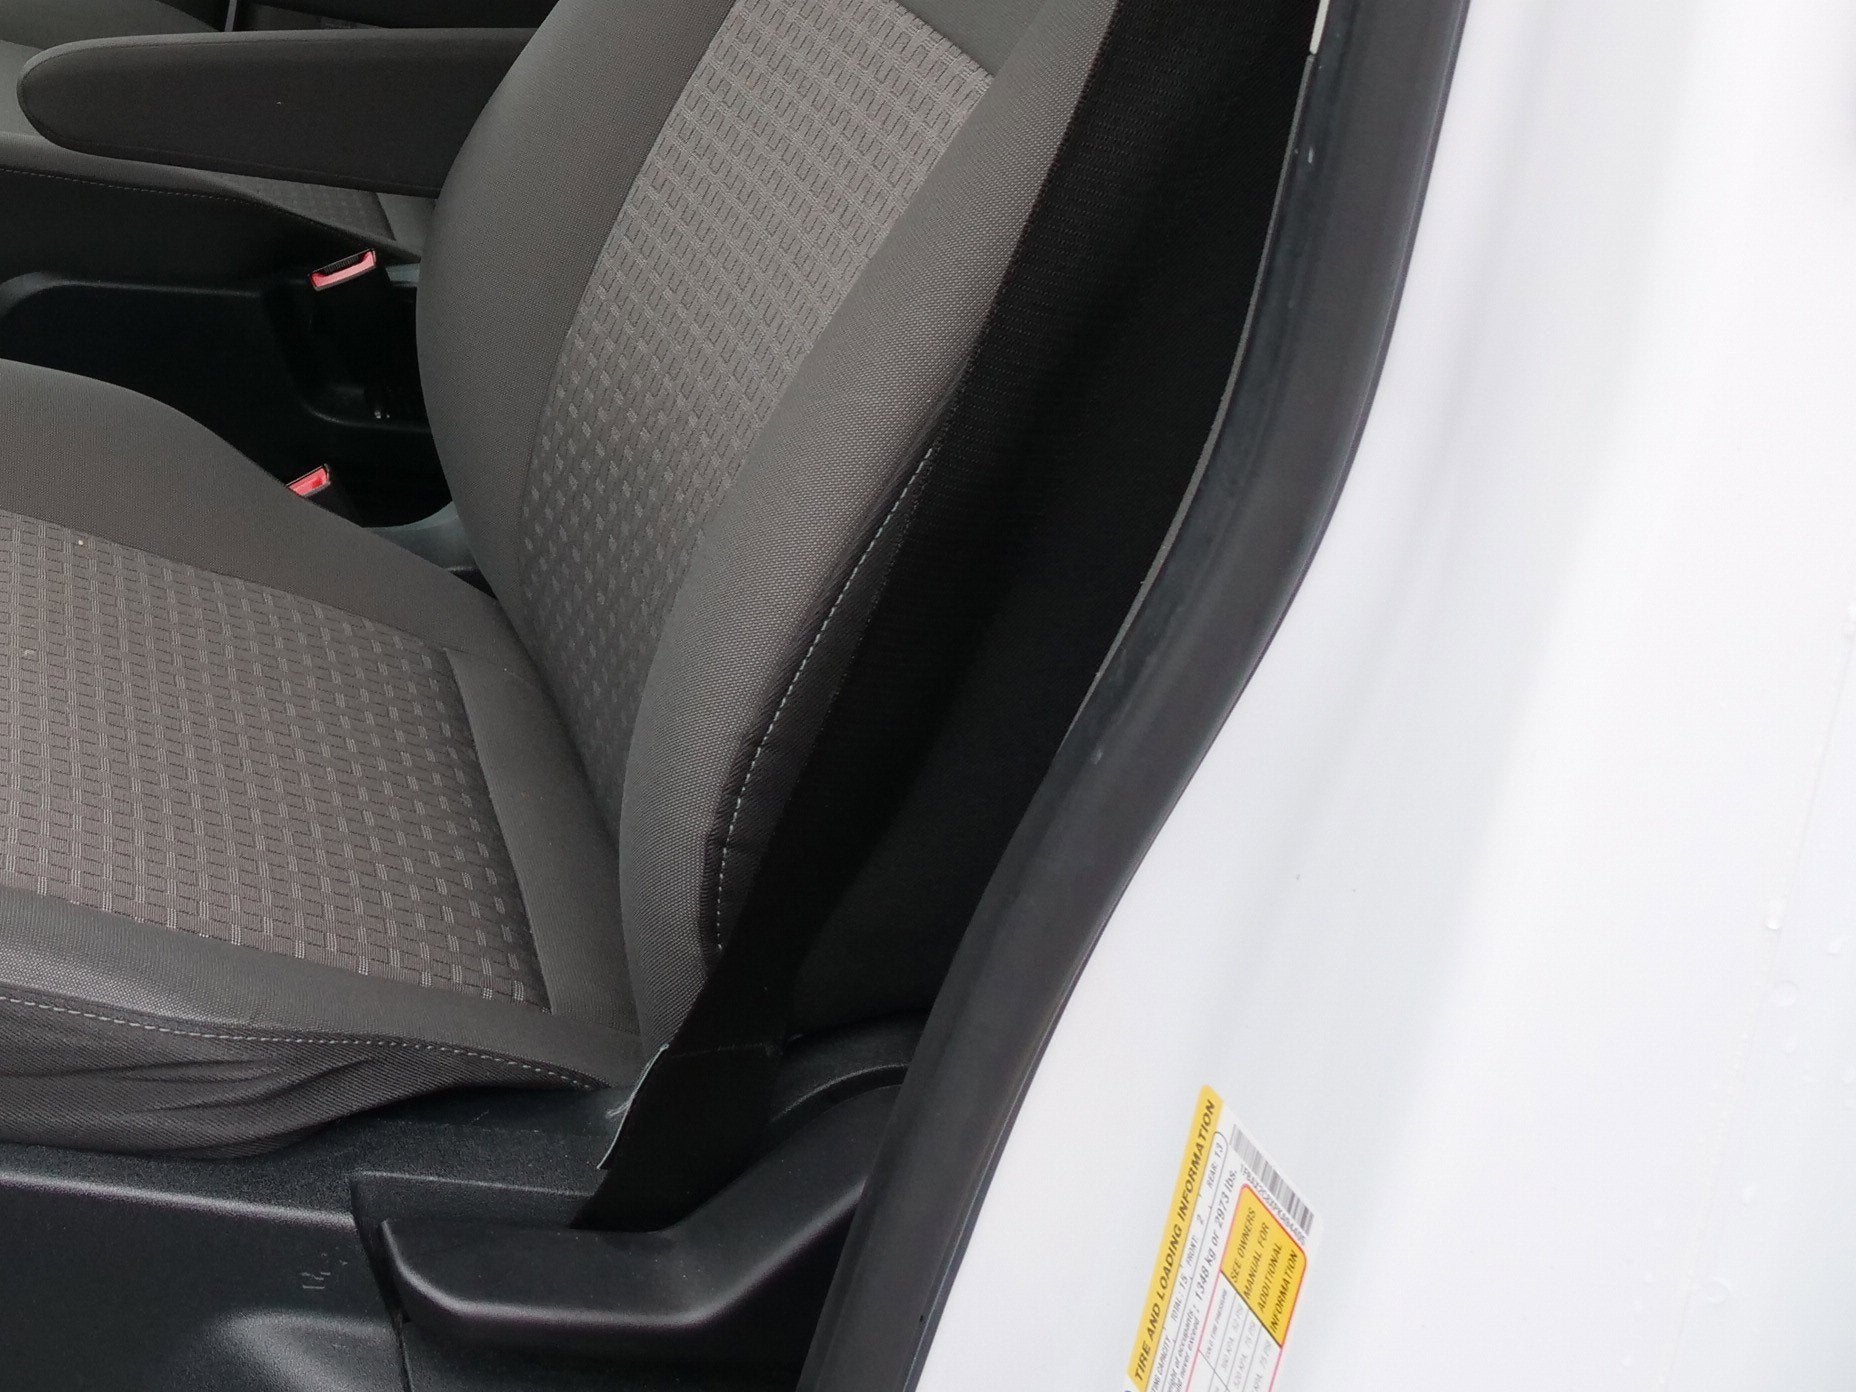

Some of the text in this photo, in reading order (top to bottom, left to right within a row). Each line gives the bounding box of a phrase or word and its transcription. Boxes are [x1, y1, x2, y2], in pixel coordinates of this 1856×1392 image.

[1214, 1142, 1223, 1158] 13
[1135, 1100, 1214, 1380] TIRE AND LOADING INFORMATION
[1195, 1265, 1209, 1300] 1348
[1204, 1248, 1216, 1266] kg
[1211, 1230, 1219, 1246] or
[1215, 1191, 1229, 1228] 2973
[1197, 1214, 1203, 1225] 2
[1231, 1207, 1255, 1283] SEE OWNERS
[1179, 1273, 1187, 1289] 15
[1243, 1222, 1269, 1299] MANUAL FOR
[1258, 1243, 1282, 1312] ADDITIONAL
[1270, 1250, 1297, 1332] INFORMATION
